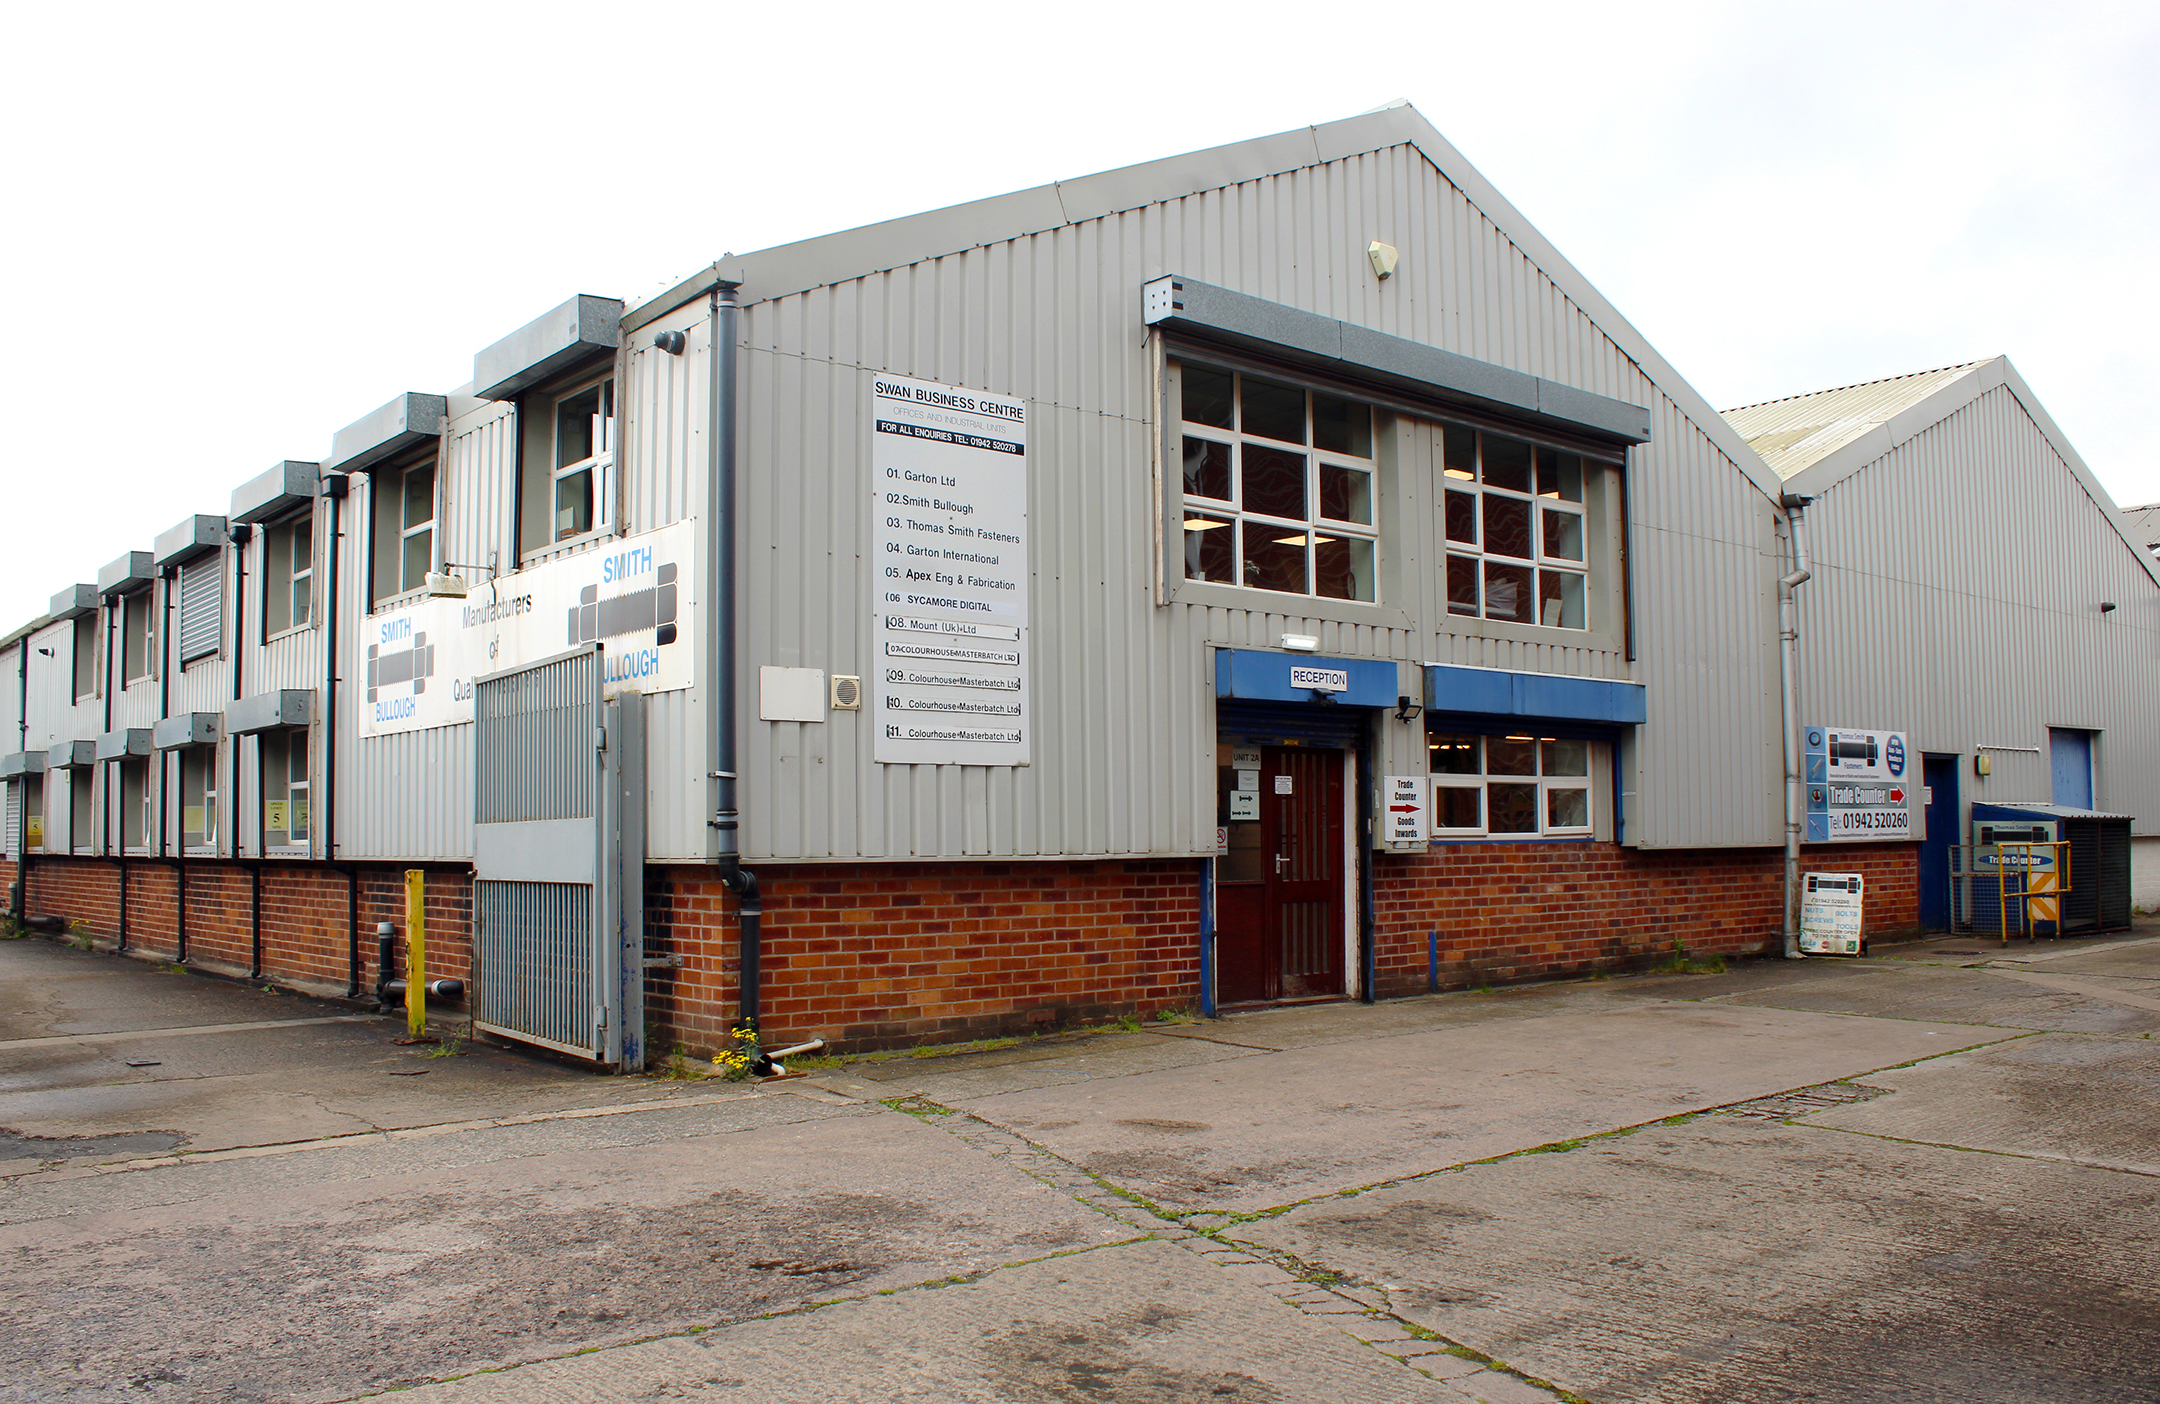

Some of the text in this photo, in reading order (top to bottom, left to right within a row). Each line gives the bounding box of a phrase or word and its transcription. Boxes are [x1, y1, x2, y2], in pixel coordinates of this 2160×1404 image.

[875, 381, 1024, 419] SWAN BUSINESS CENTRE
[893, 406, 1007, 434] OFFICES AND INDUSTRIAL UNITS
[881, 422, 1017, 453] FOR ALL ENQUIRIES TEL: 01942 520278
[886, 467, 956, 487] 01. Garton Ltd
[933, 499, 974, 516] Bullough
[886, 516, 1020, 544] 03. Thomas Smith Fasteners
[886, 542, 999, 565] 04. Garton International
[603, 545, 652, 584] SMITH
[885, 566, 1016, 591] 05. Apex Eng & Fabrication
[462, 593, 532, 629] Manufacturers
[907, 595, 958, 609] SYCAMORE
[960, 600, 992, 612] DIGITAL
[381, 616, 411, 644] SMITH
[910, 620, 938, 631] Mount
[941, 622, 960, 633] (Uk)
[963, 624, 977, 634] Ltd
[488, 633, 500, 660] of
[900, 645, 954, 657] COLOURHOUSE
[955, 650, 1003, 661] MASTERBATCH
[603, 648, 659, 684] ULLOUGH
[909, 673, 957, 685] Colourhouse
[960, 677, 1005, 688] Masterbatch
[1293, 670, 1345, 685] RECEPTION
[376, 696, 416, 722] BULLOUGH
[908, 699, 957, 711] Colourhouse
[960, 702, 1005, 713] Masterbatch
[908, 728, 957, 739] Colourhouse
[960, 731, 1005, 740] Masterbatch
[1233, 753, 1260, 762] UNIT 2A
[1397, 779, 1414, 789] Trade
[1394, 791, 1417, 801] Counter
[1829, 785, 1886, 805] Trade Counter
[273, 812, 280, 823] 5
[1397, 816, 1415, 826] Goods
[1828, 812, 1908, 829] Tel: 01942 520260
[1394, 829, 1418, 838] Inwards
